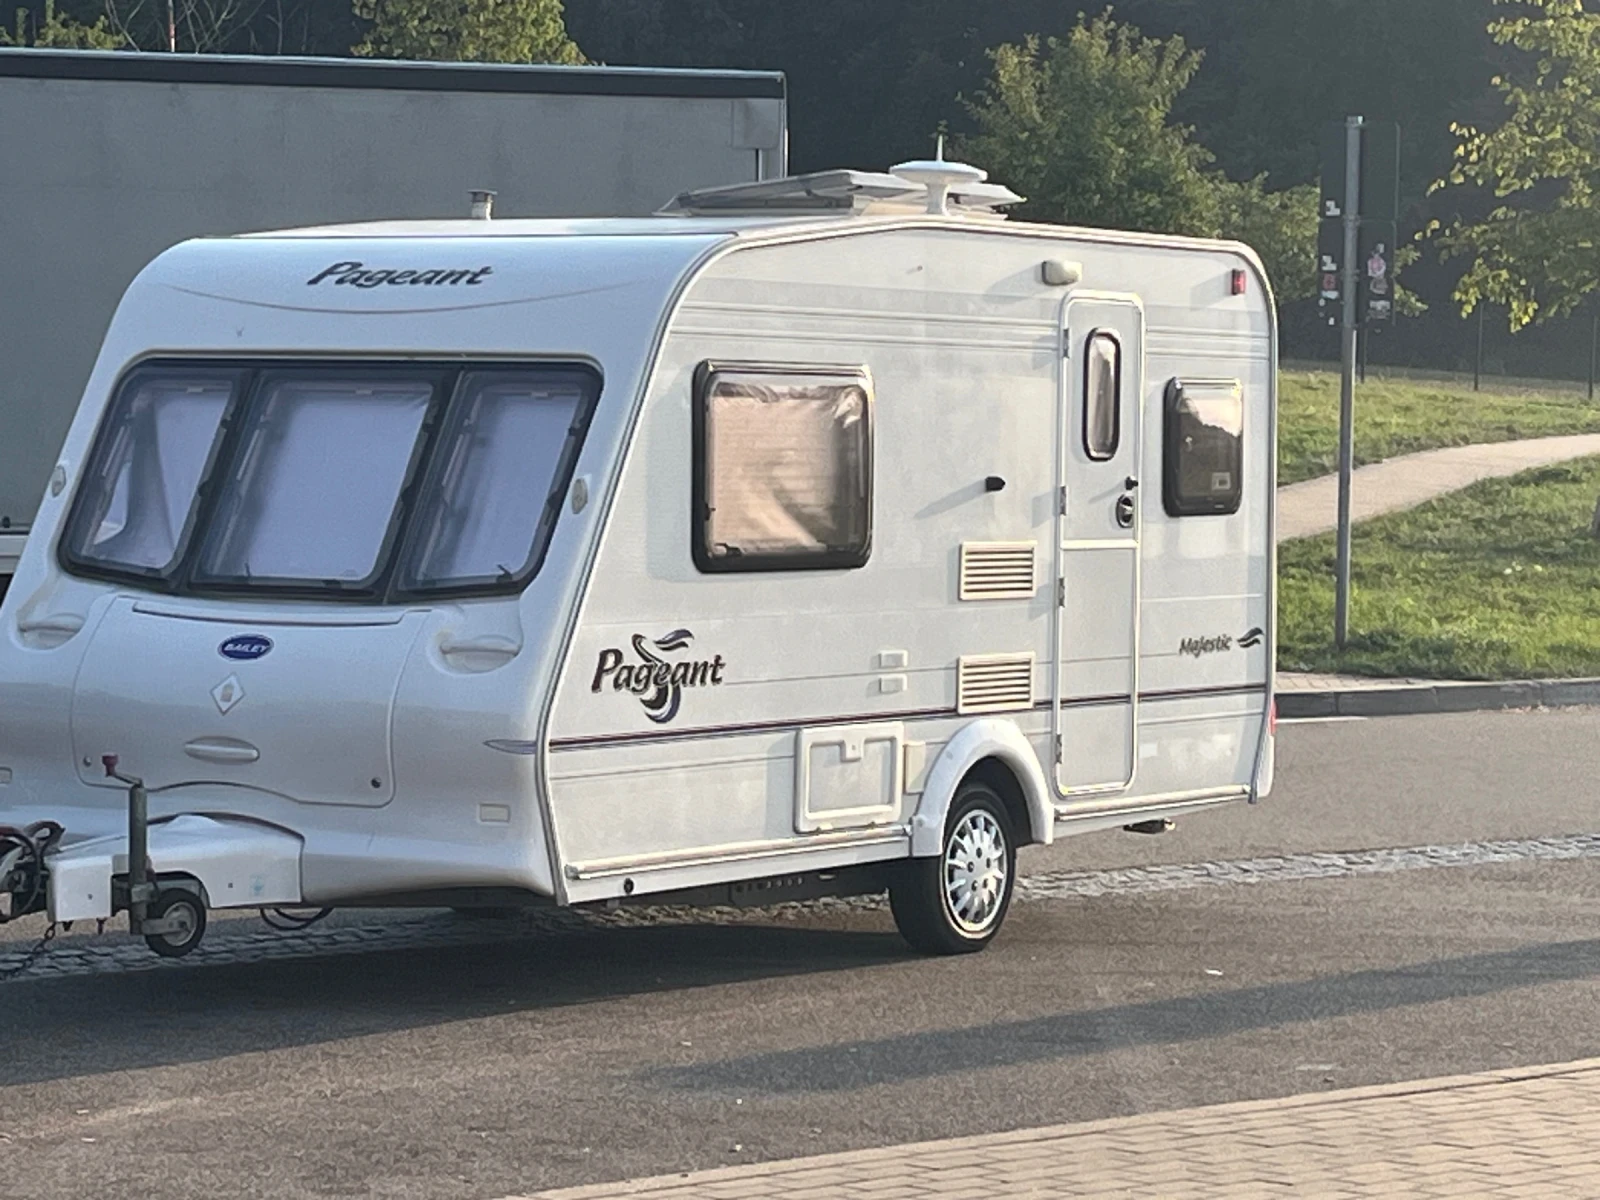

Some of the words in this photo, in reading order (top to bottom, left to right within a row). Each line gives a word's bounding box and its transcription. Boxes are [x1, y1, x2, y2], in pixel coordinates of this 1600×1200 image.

[307, 261, 493, 289] Pageant
[1179, 633, 1232, 658] Majestic
[591, 648, 726, 695] Pageant
